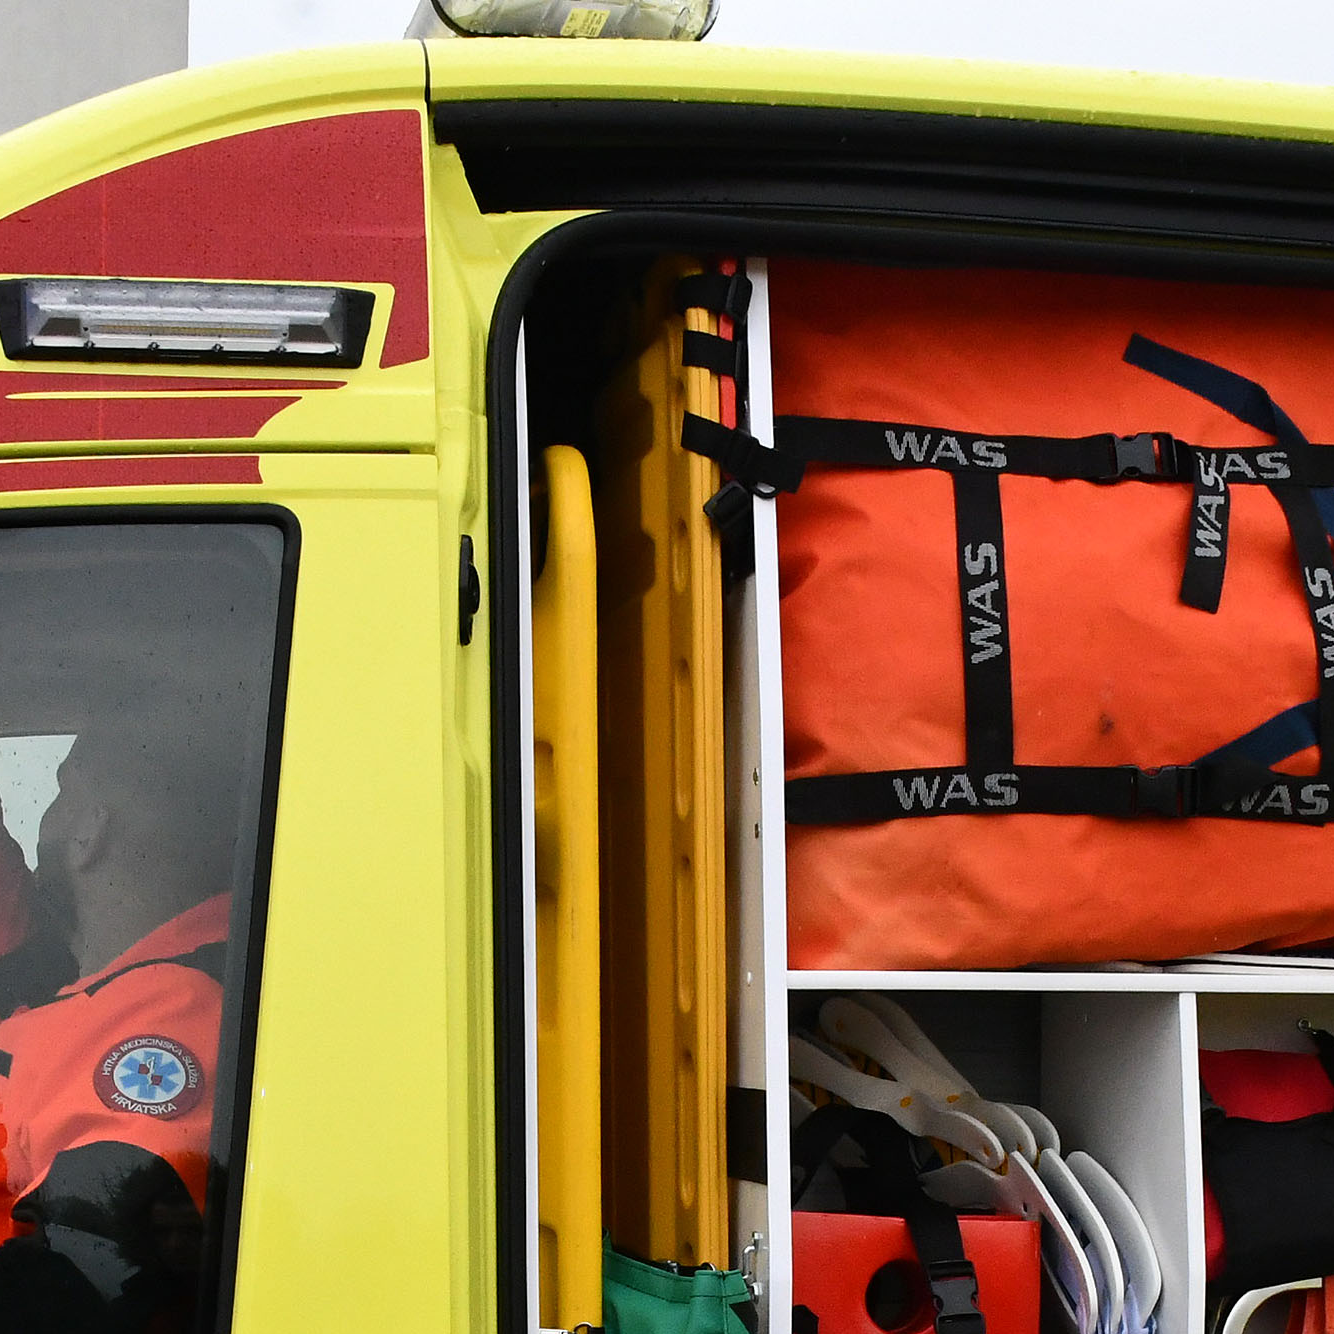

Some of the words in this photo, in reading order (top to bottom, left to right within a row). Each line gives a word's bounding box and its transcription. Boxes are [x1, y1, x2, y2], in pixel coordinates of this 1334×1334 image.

[884, 430, 1008, 468] WAS
[1194, 459, 1225, 558] WAS
[964, 542, 1003, 664] WAS
[893, 773, 1019, 811] WAS
[102, 1051, 122, 1076] HITNA
[120, 1038, 183, 1057] MEDICINSKA
[110, 1092, 178, 1115] HRVATSKA
